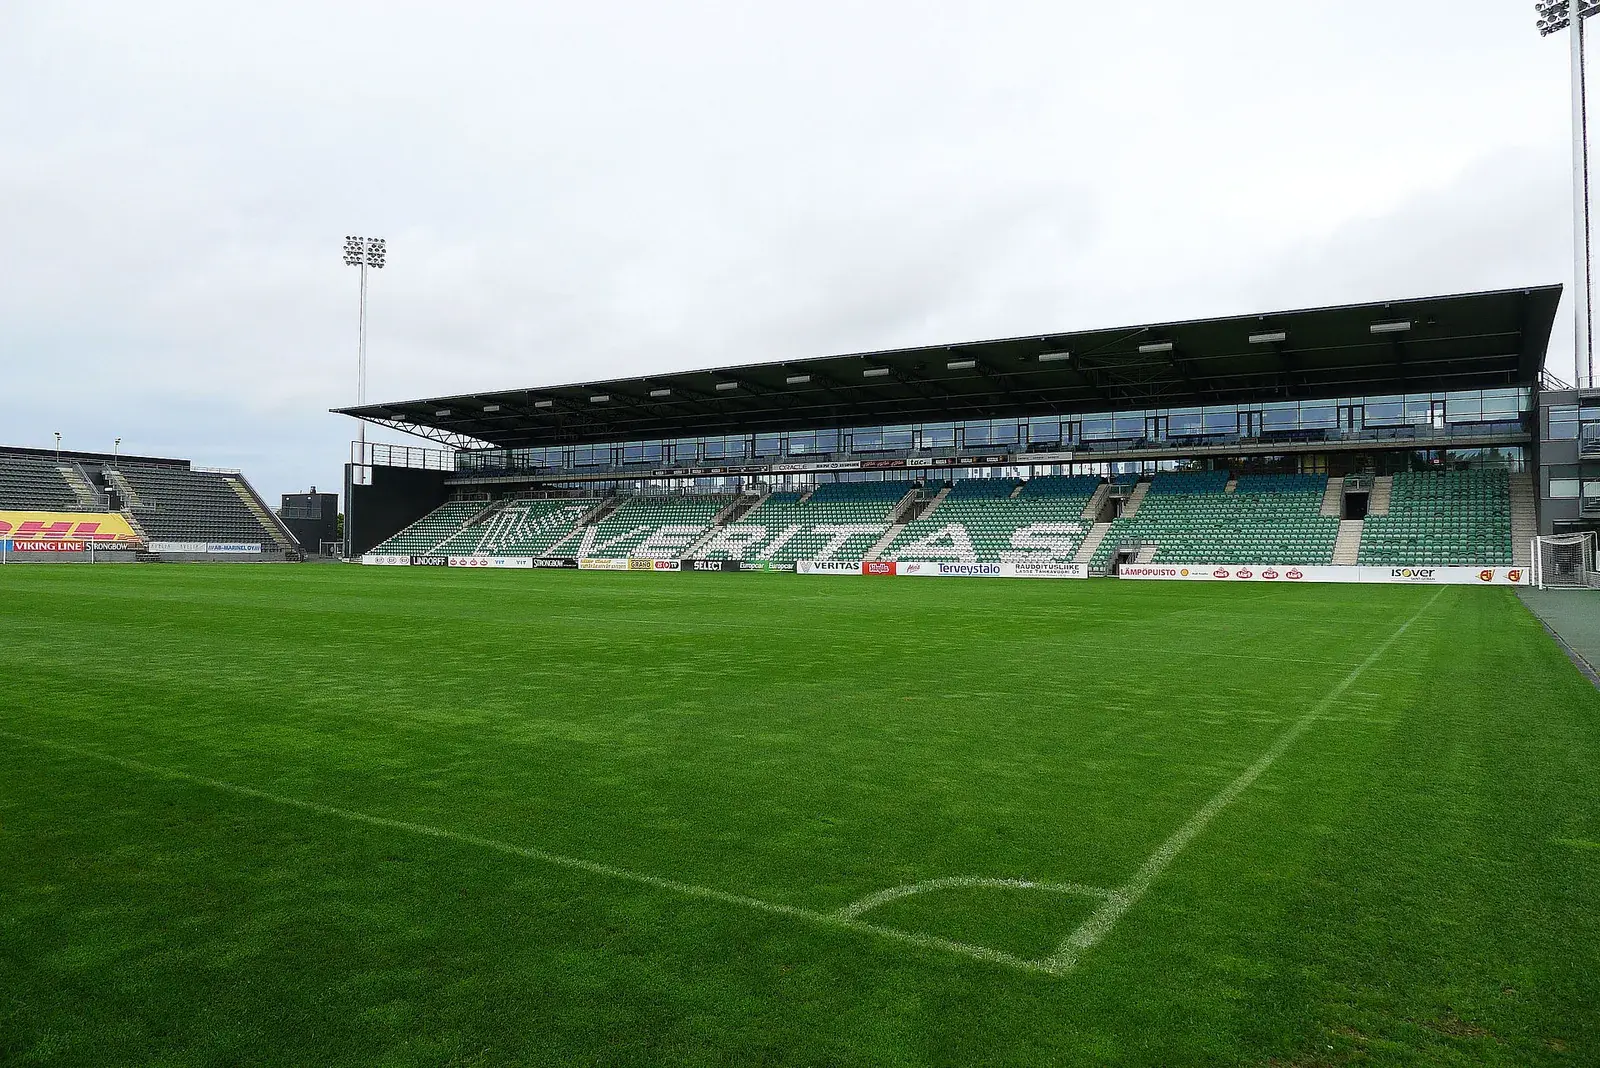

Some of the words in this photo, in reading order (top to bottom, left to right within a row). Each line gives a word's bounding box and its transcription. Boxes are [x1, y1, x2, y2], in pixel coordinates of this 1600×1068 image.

[0, 521, 117, 540] HL
[16, 541, 56, 551] VIKING
[58, 541, 81, 551] LINE
[86, 542, 128, 551] STRONGBOW
[413, 557, 446, 566] LINDORFF
[693, 561, 723, 571] SELECT
[814, 562, 860, 570] VERITAS
[938, 563, 1001, 575] Terveystalo
[1120, 568, 1176, 577] LÄMPÖPUISTO
